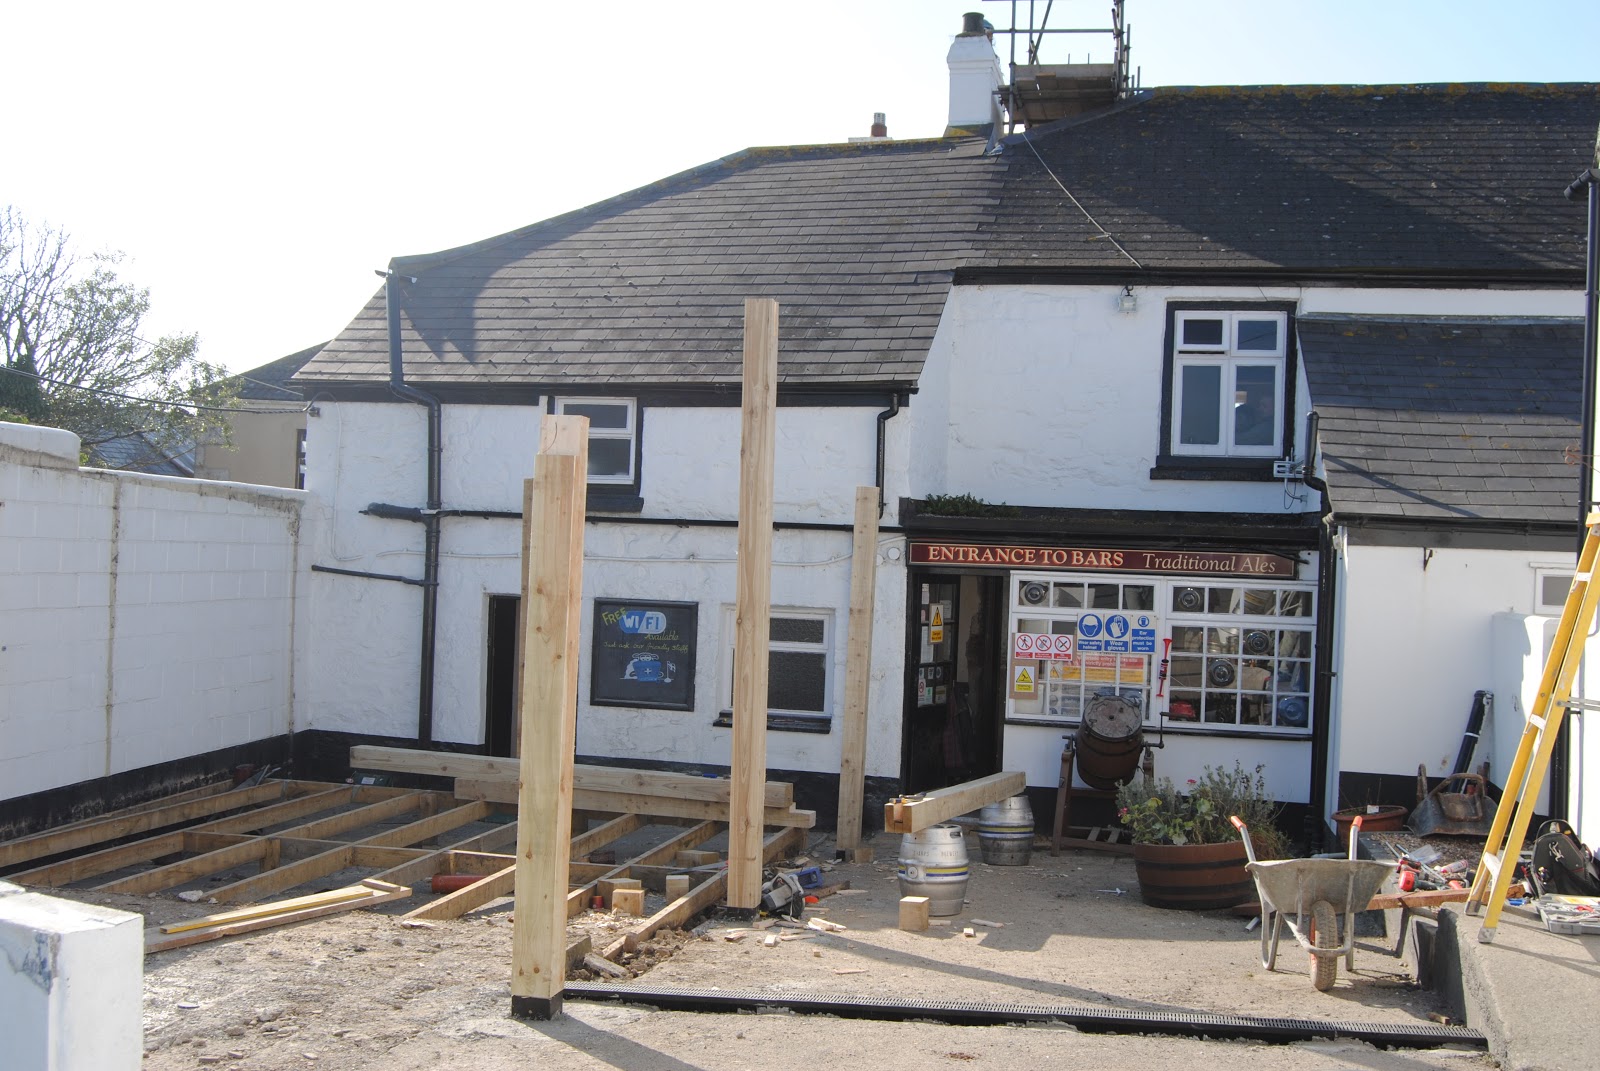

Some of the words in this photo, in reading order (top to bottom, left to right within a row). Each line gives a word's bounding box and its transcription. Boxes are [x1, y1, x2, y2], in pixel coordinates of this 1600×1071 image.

[928, 546, 1036, 563] ENTRANCE
[1040, 549, 1067, 565] TO
[1071, 550, 1124, 567] BARS
[1143, 553, 1236, 571] Traditional
[1240, 558, 1276, 573] Ales
[602, 607, 627, 626] FREE
[644, 630, 679, 641] Available
